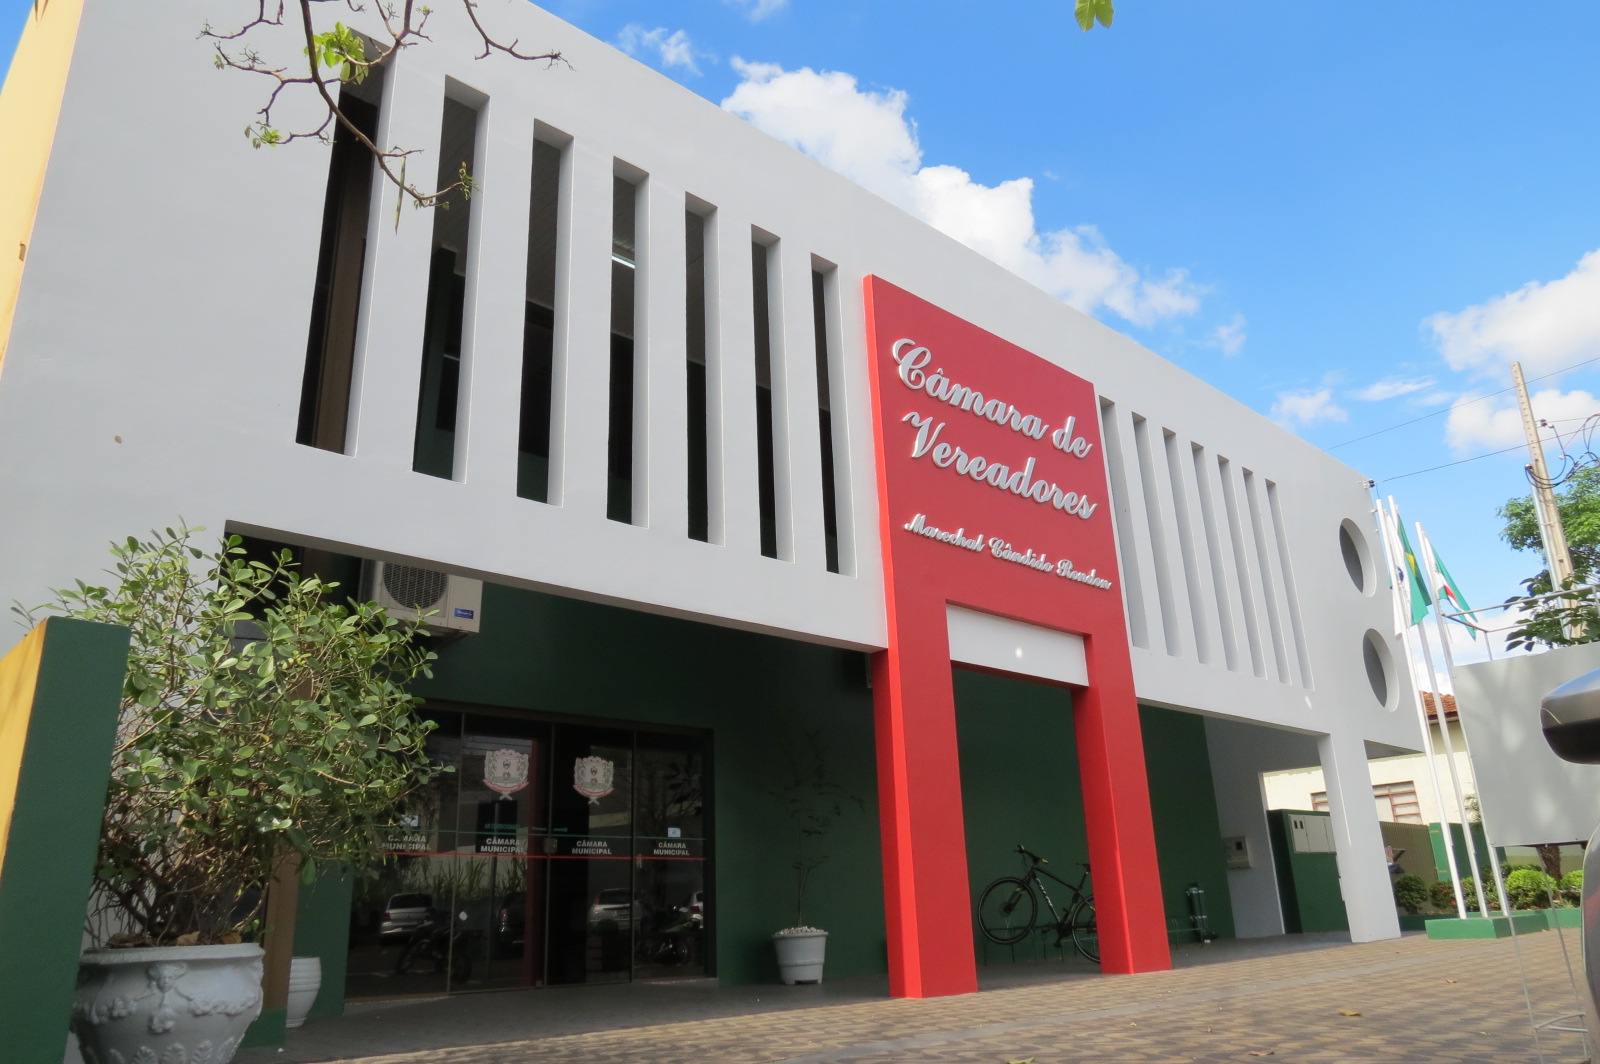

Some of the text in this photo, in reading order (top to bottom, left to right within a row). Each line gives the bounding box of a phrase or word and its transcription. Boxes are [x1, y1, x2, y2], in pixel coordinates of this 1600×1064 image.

[892, 338, 1093, 458] Câmara de
[902, 412, 1098, 519] Vereadores
[903, 513, 1113, 590] Marechal Cândido Rondon
[480, 845, 525, 853] MUNICIPAL
[486, 836, 521, 845] CÂMARA
